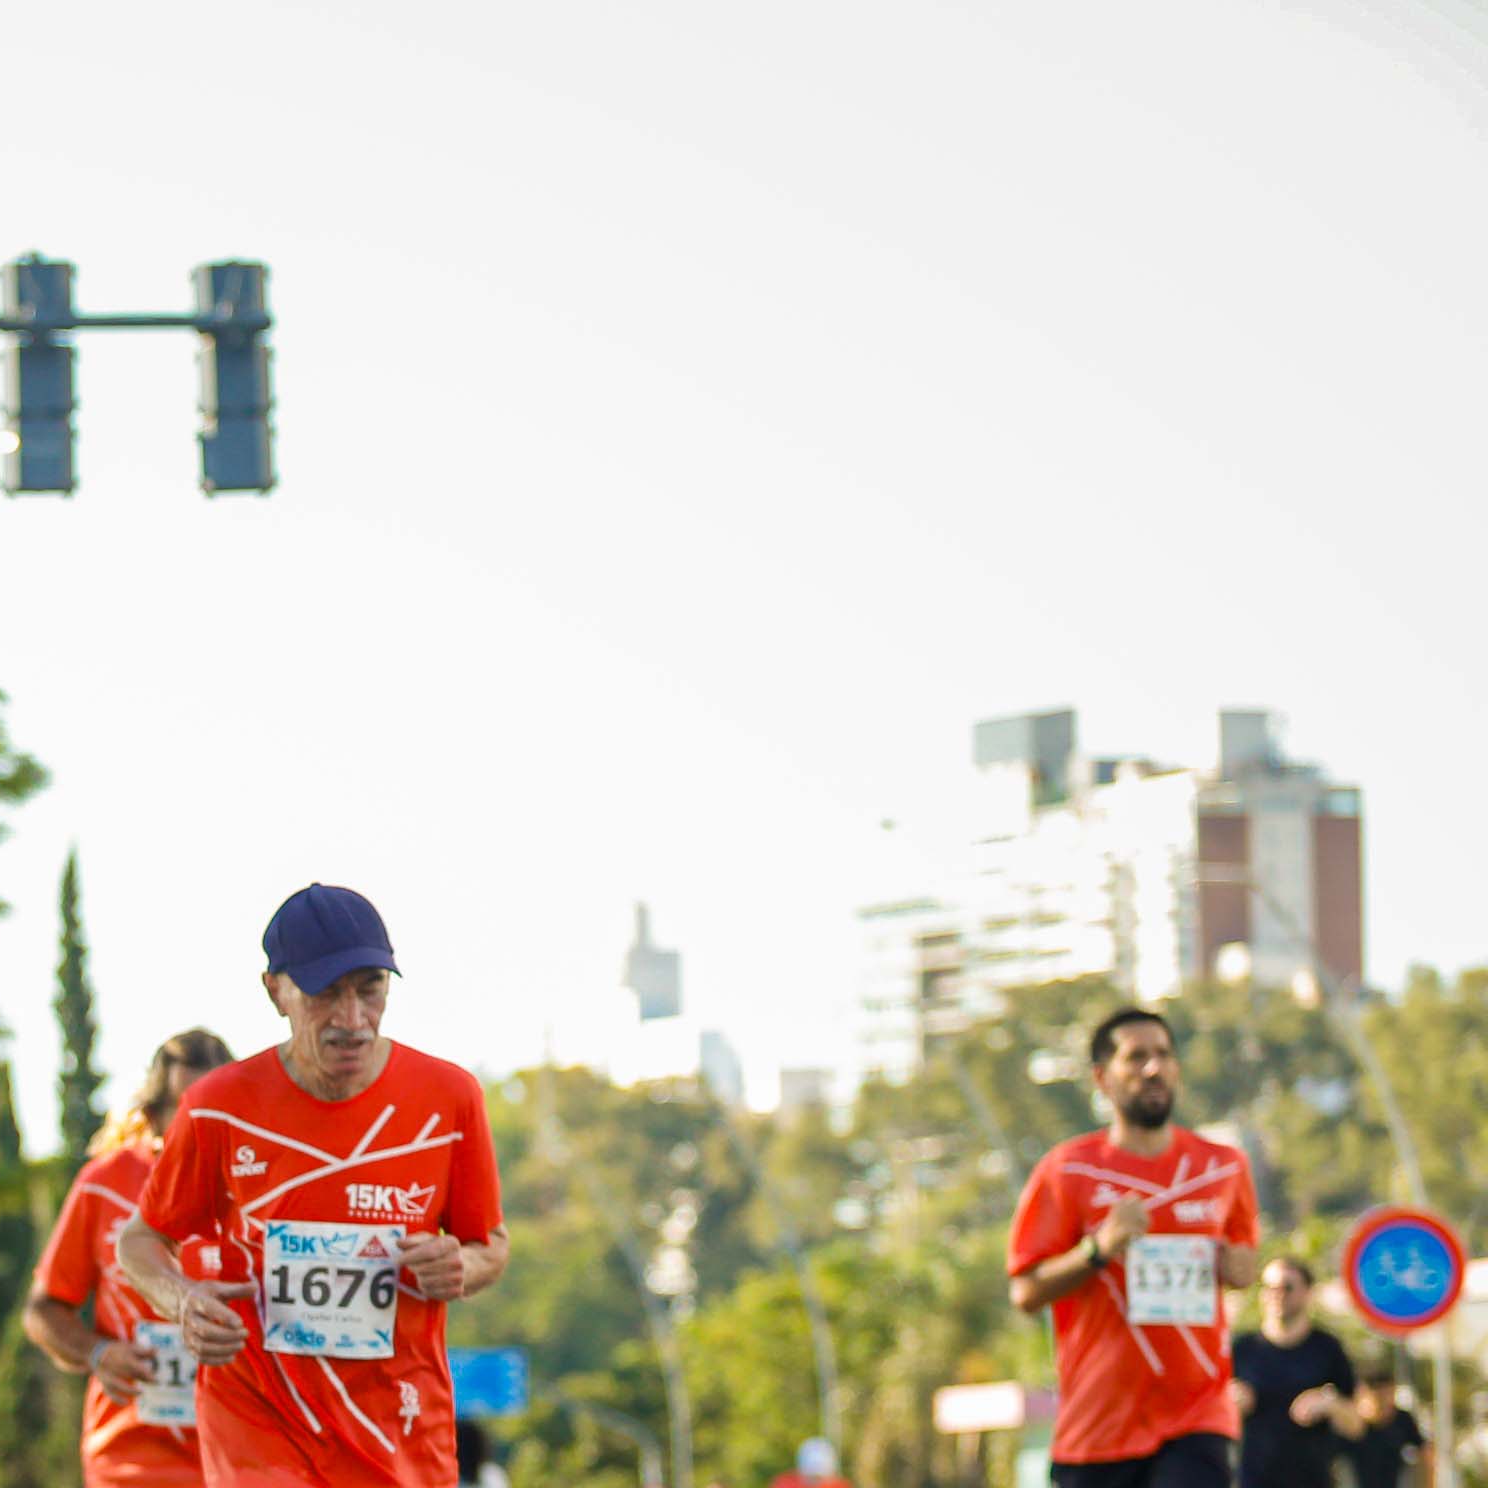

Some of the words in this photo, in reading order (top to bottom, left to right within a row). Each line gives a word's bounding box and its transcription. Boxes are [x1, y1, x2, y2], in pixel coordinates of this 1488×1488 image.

[346, 1183, 394, 1212] 15K
[279, 1234, 316, 1254] 15K
[271, 1265, 396, 1310] 1676
